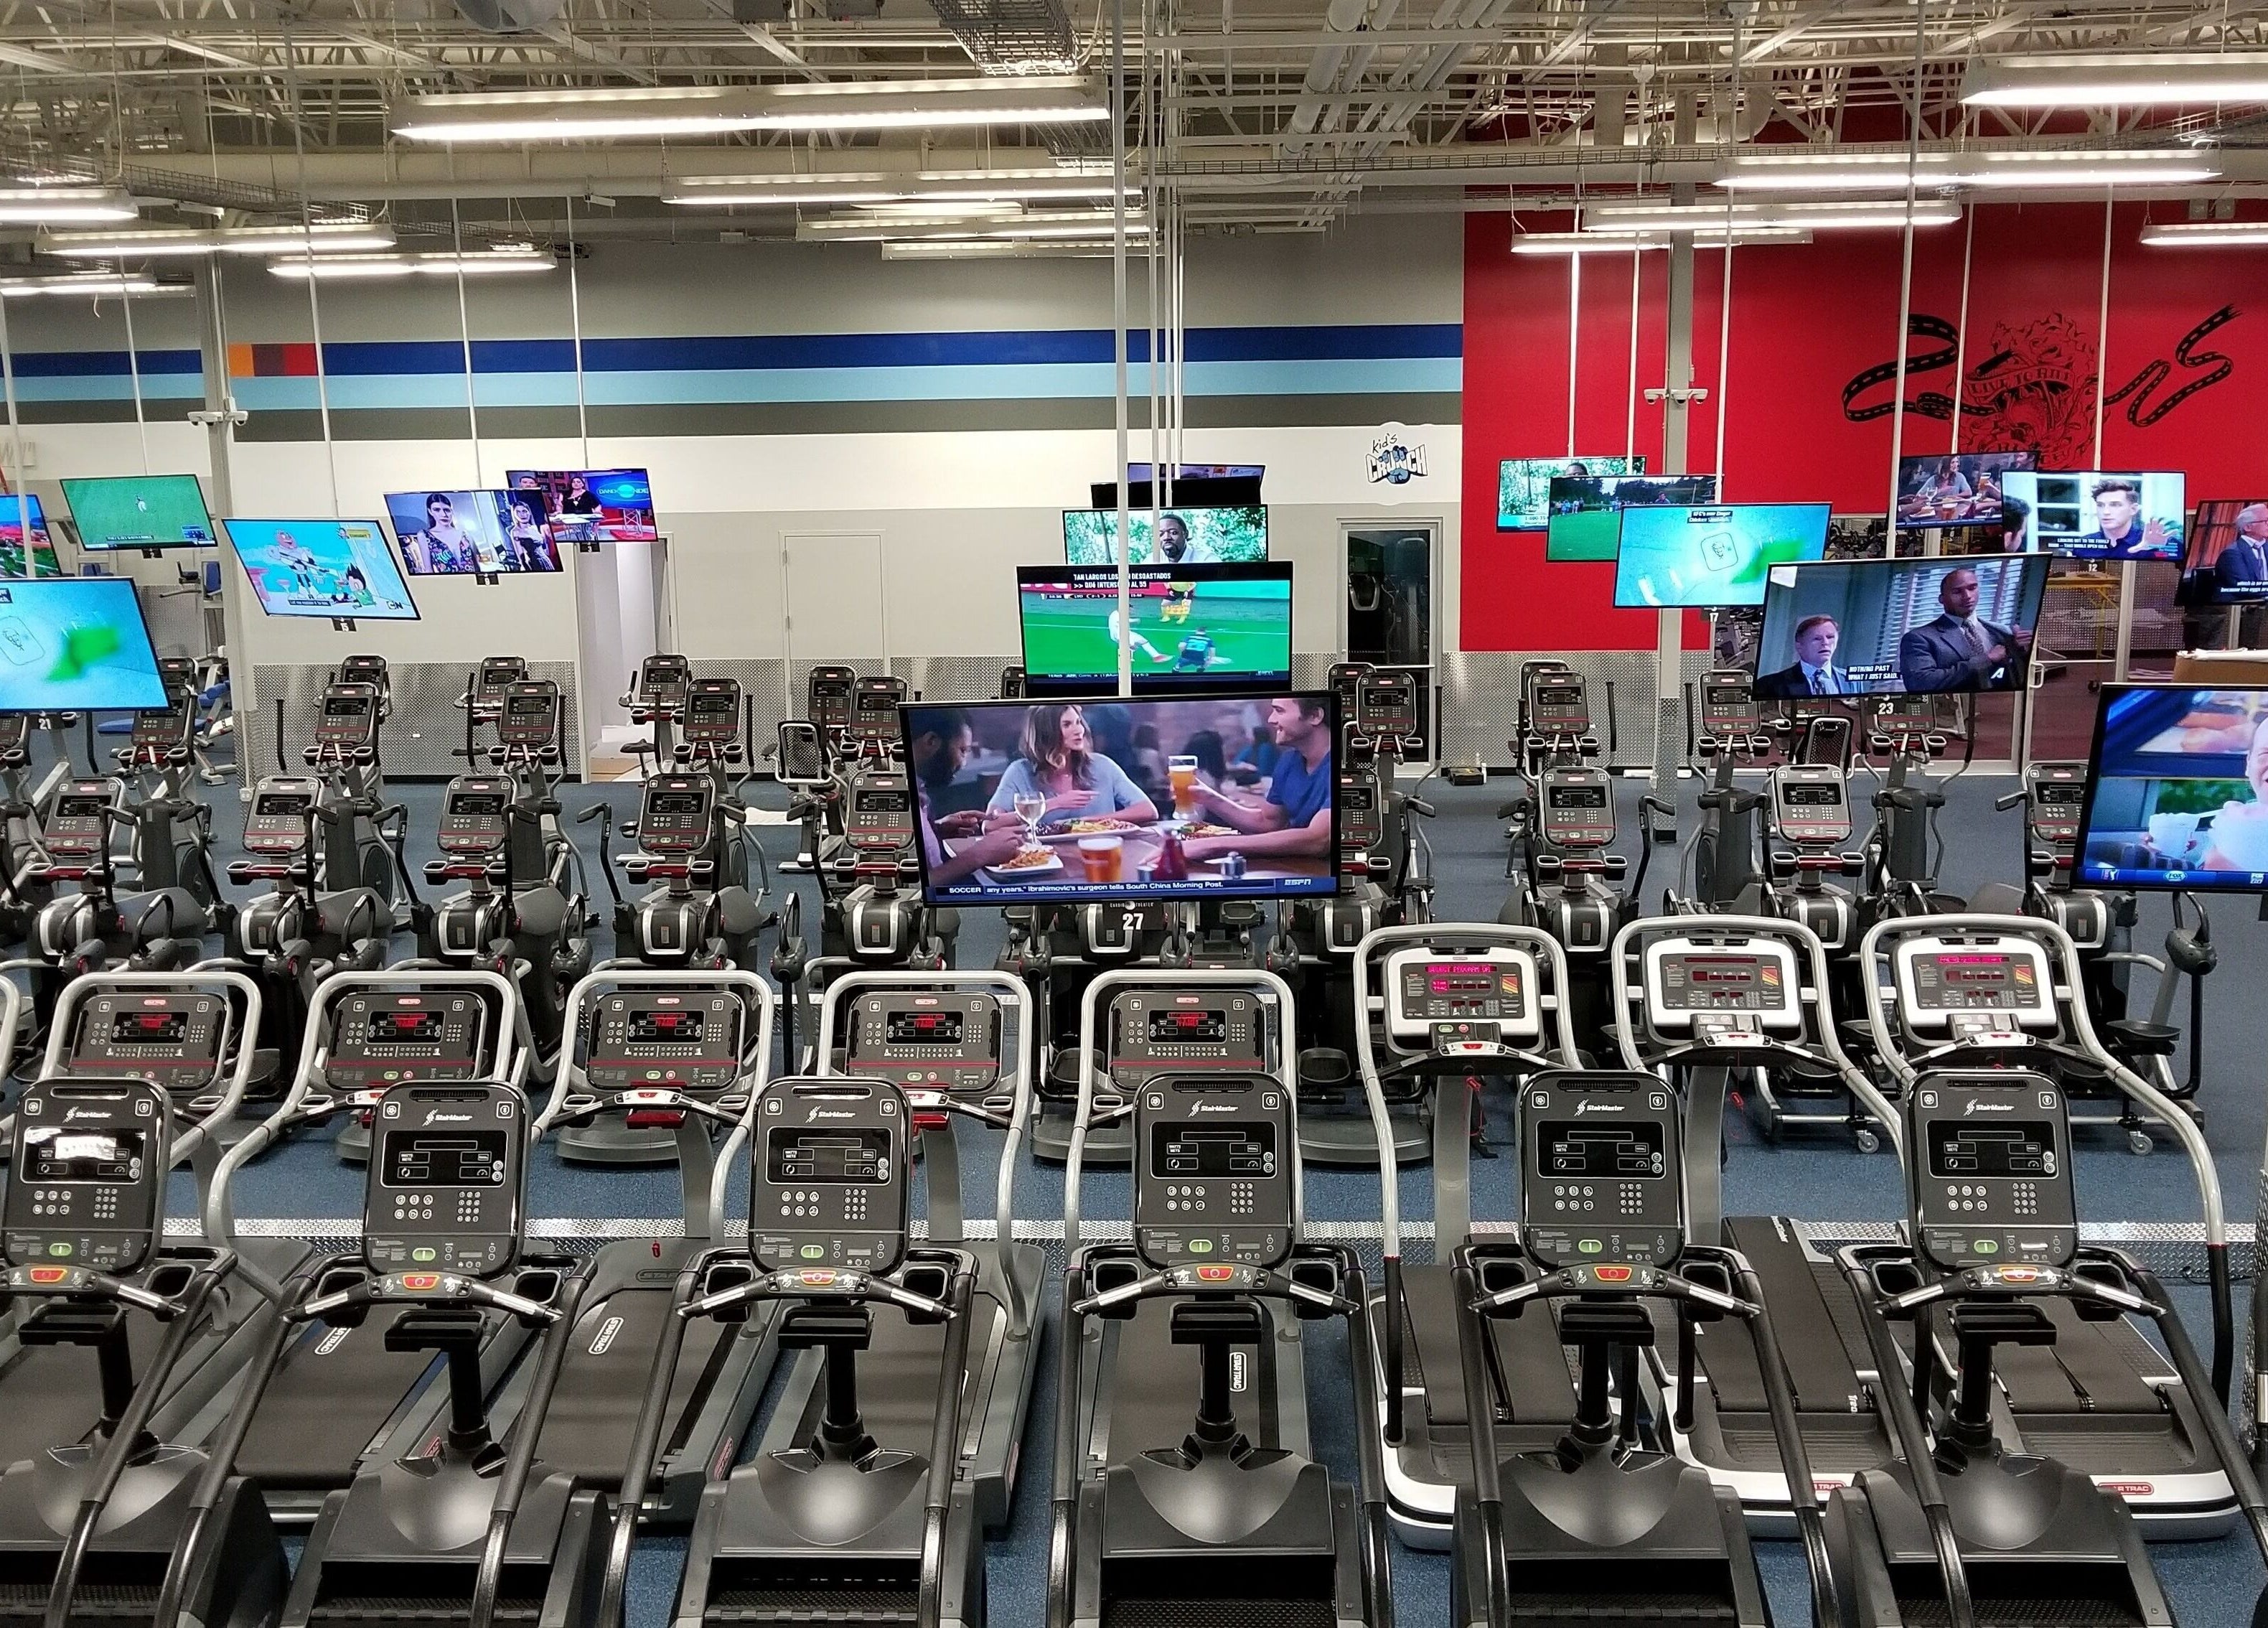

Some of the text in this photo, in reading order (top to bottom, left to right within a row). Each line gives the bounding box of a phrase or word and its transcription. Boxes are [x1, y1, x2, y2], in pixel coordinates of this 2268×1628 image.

[1366, 444, 1428, 483] CRUNCH
[2088, 563, 2098, 572] 12
[385, 600, 404, 610] CN
[1710, 612, 1719, 622] 17
[340, 622, 350, 632] 15
[1878, 703, 1894, 715] 23
[38, 718, 52, 730] 21
[1284, 878, 1312, 886] ESPN
[1122, 912, 1144, 930] 27
[320, 1335, 340, 1352] TRAC
[594, 1334, 611, 1352] TRAC
[1233, 1353, 1242, 1389] STAR TRAC
